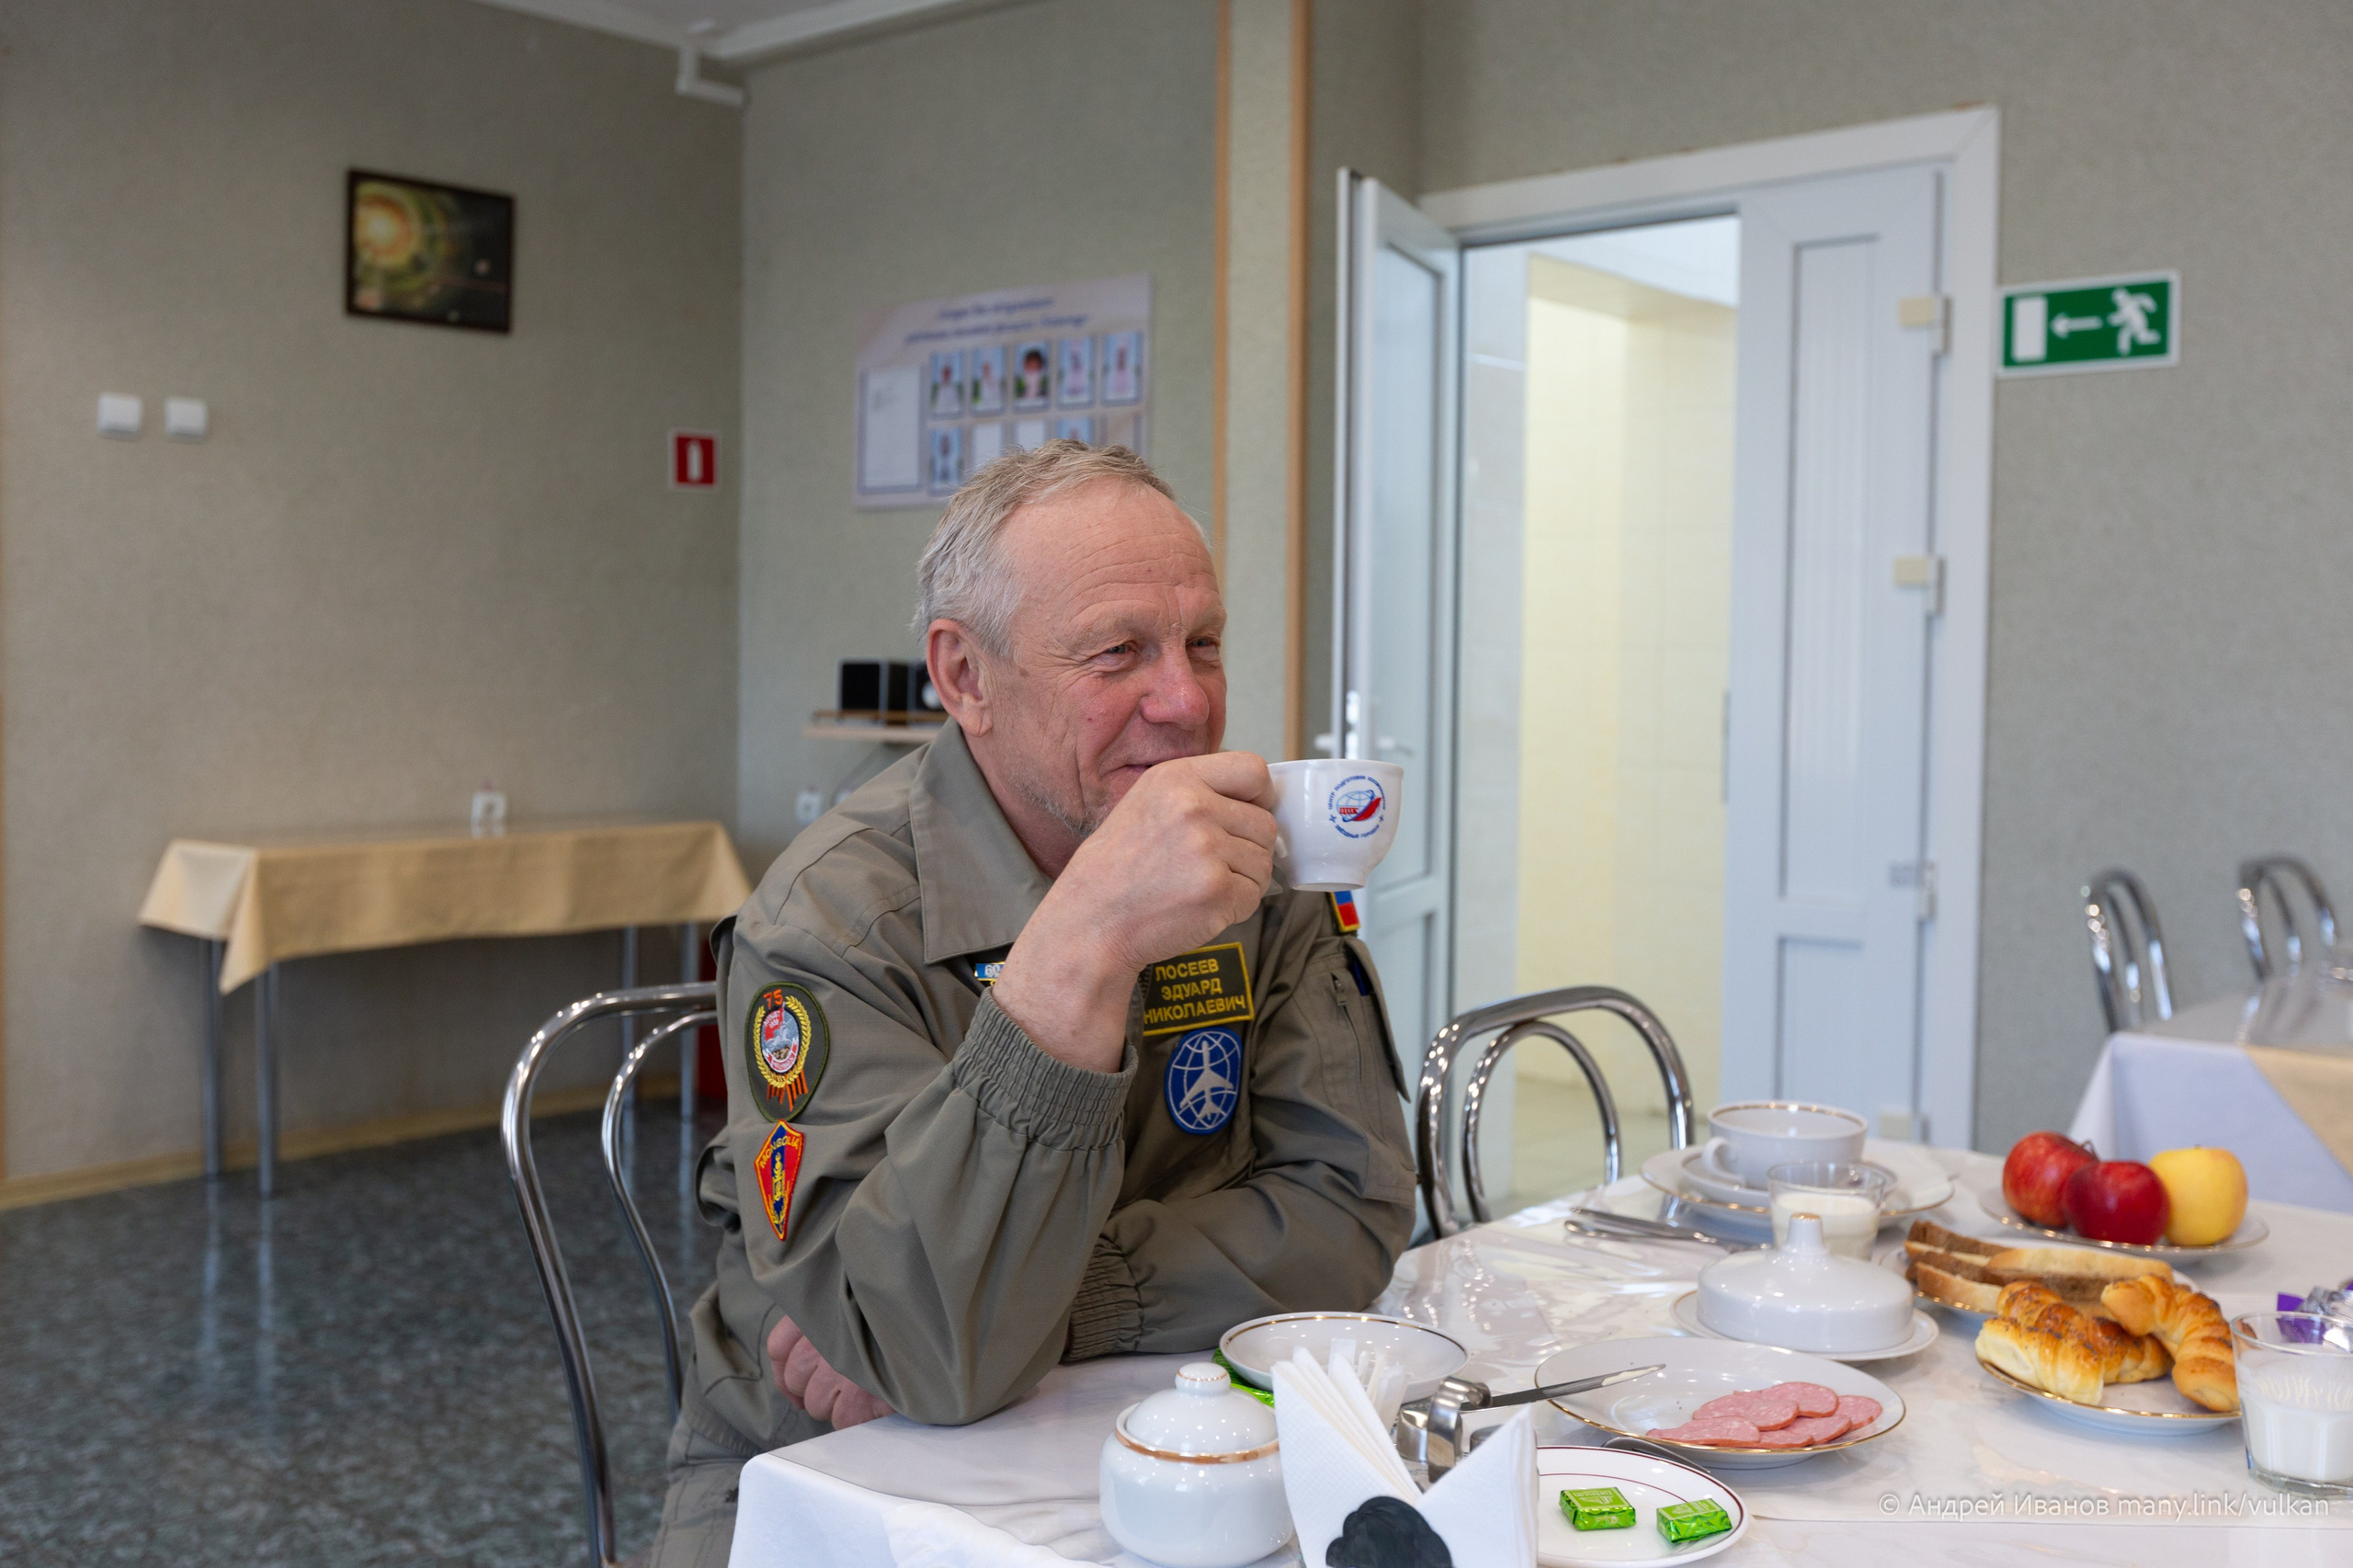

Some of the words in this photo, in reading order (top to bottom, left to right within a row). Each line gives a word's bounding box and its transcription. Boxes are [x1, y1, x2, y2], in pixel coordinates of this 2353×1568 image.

[1154, 958, 1220, 983] ЛОСЕЕВ
[763, 988, 783, 1009] 75
[1161, 977, 1223, 1001] ЭДУАРД
[1143, 994, 1246, 1025] НИКОЛАЕВИЧ
[759, 1135, 800, 1169] MONGOLIA
